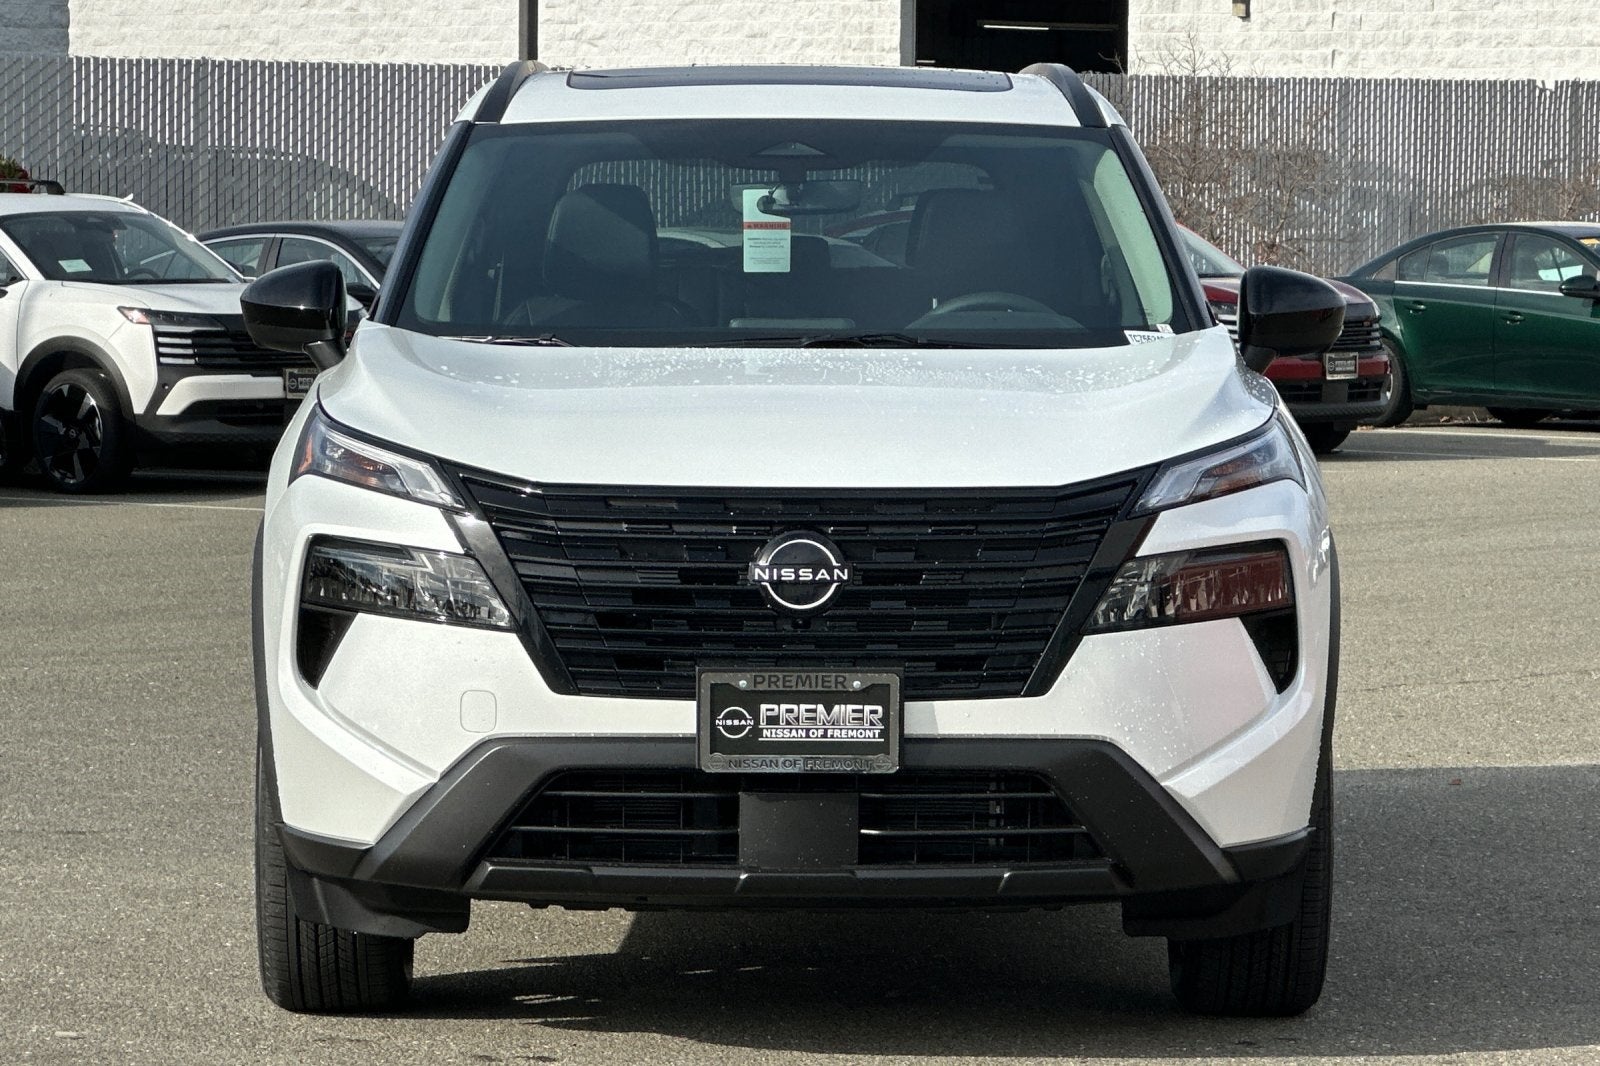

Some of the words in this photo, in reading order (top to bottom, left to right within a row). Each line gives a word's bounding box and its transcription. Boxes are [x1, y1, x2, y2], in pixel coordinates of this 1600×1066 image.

[754, 568, 848, 581] NISSAN
[753, 674, 847, 690] PREMIER
[759, 703, 883, 726] PREMIER
[762, 729, 806, 738] NISSAN
[809, 729, 824, 738] OF
[827, 729, 881, 738] FREMONT
[728, 759, 779, 769] NISSAN
[781, 759, 801, 769] OF
[803, 759, 874, 770] FREMONT
